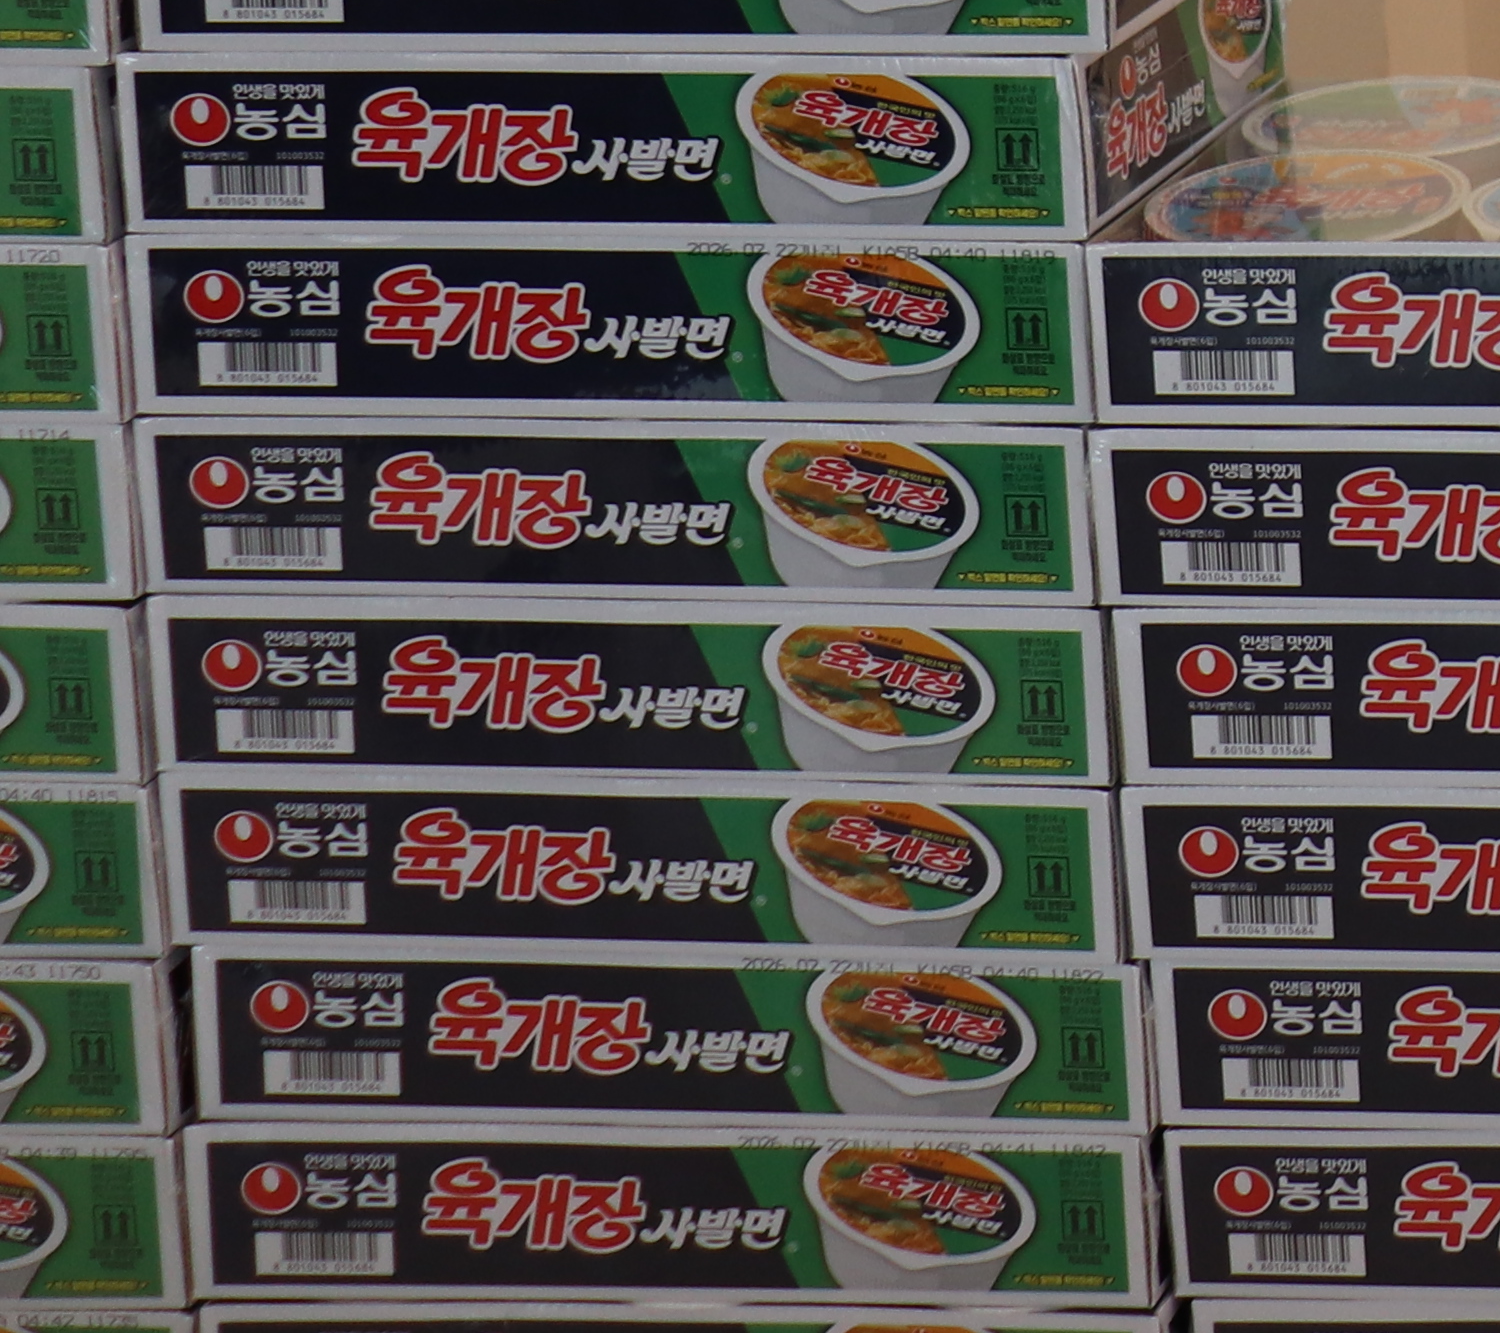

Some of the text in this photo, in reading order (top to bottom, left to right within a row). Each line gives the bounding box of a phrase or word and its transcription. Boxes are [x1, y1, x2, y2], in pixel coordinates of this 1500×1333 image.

[1201, 268, 1295, 284] 인생을 맛있게
[1202, 287, 1296, 325] 농심
[252, 464, 343, 502] 농심
[368, 450, 730, 549] 육개장 사발면
[1240, 653, 1333, 690] 농심
[278, 818, 368, 855] 농심
[393, 806, 754, 904] 육개장 사발면
